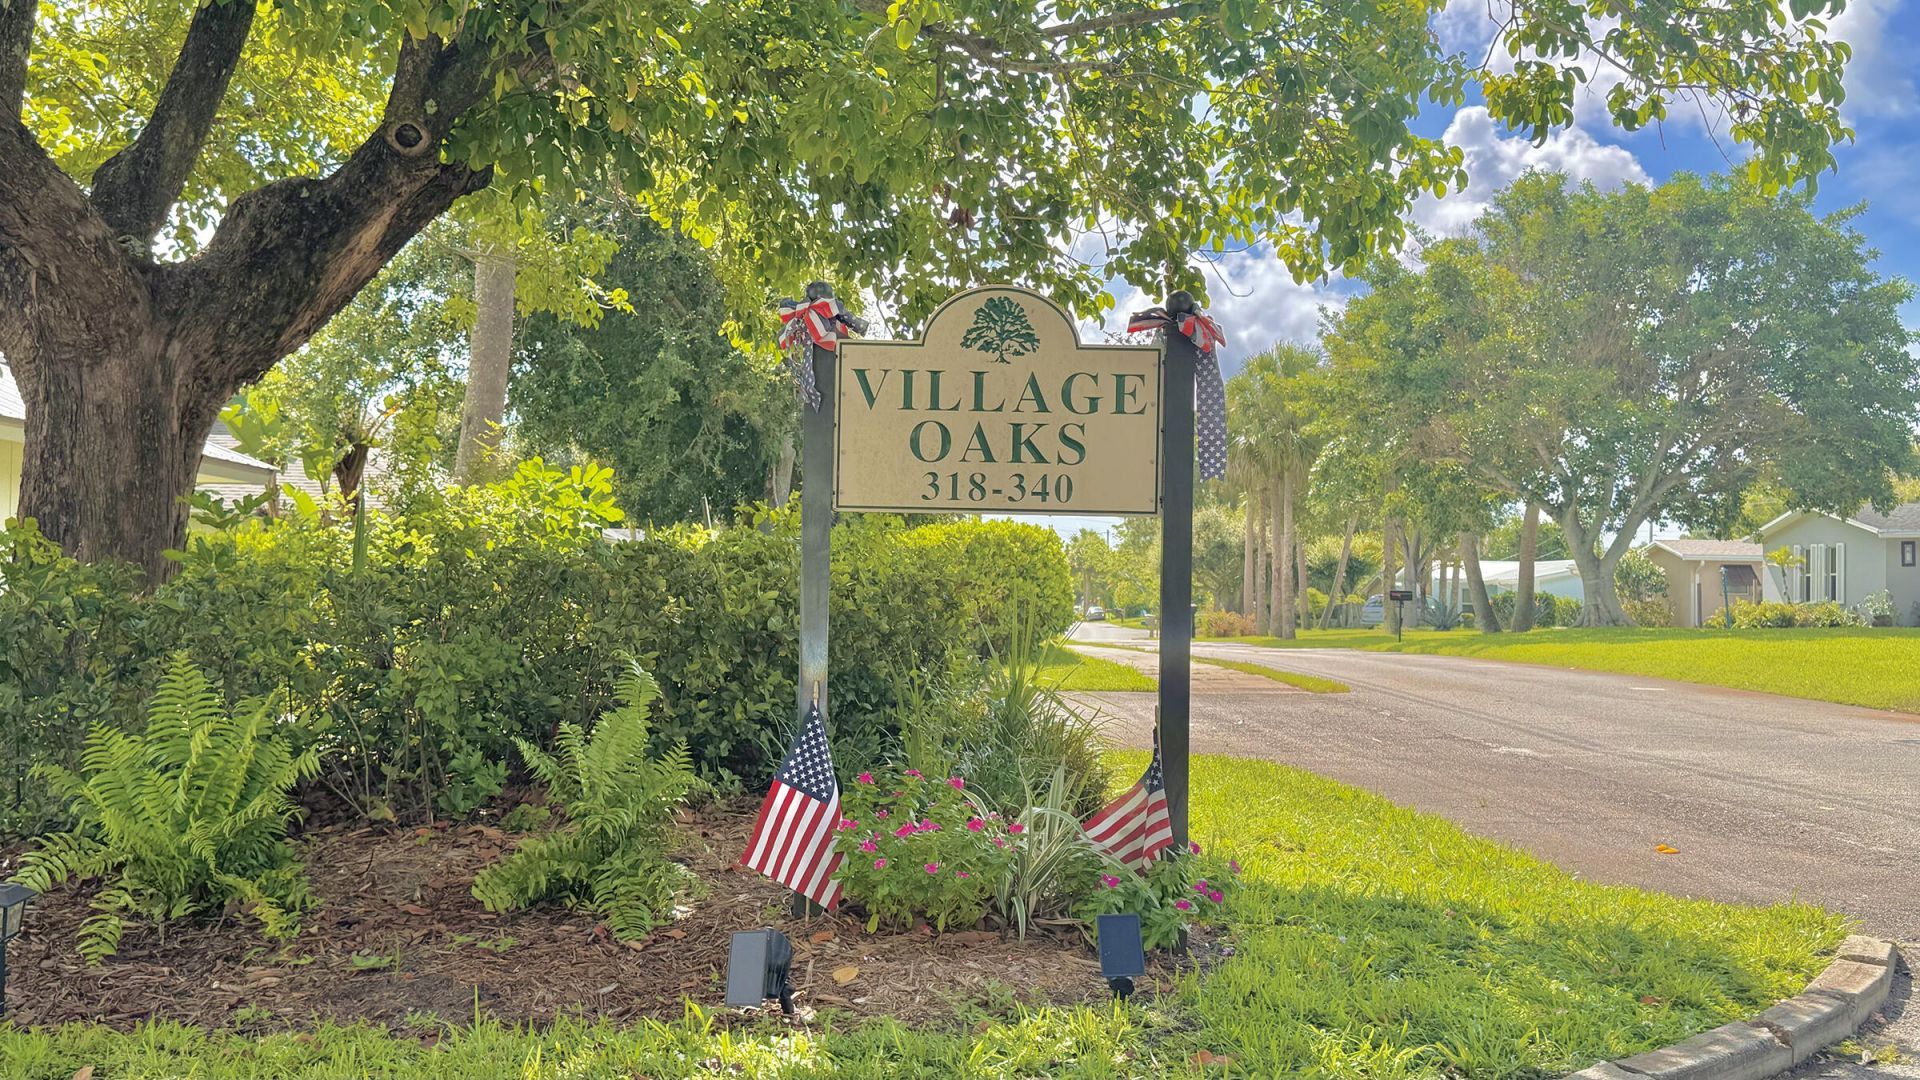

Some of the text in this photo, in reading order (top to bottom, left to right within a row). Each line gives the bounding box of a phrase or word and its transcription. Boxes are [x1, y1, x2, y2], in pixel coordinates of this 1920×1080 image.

[850, 368, 1149, 416] VILLAGE
[908, 419, 1088, 466] OAKS
[920, 470, 1074, 504] 318-340
